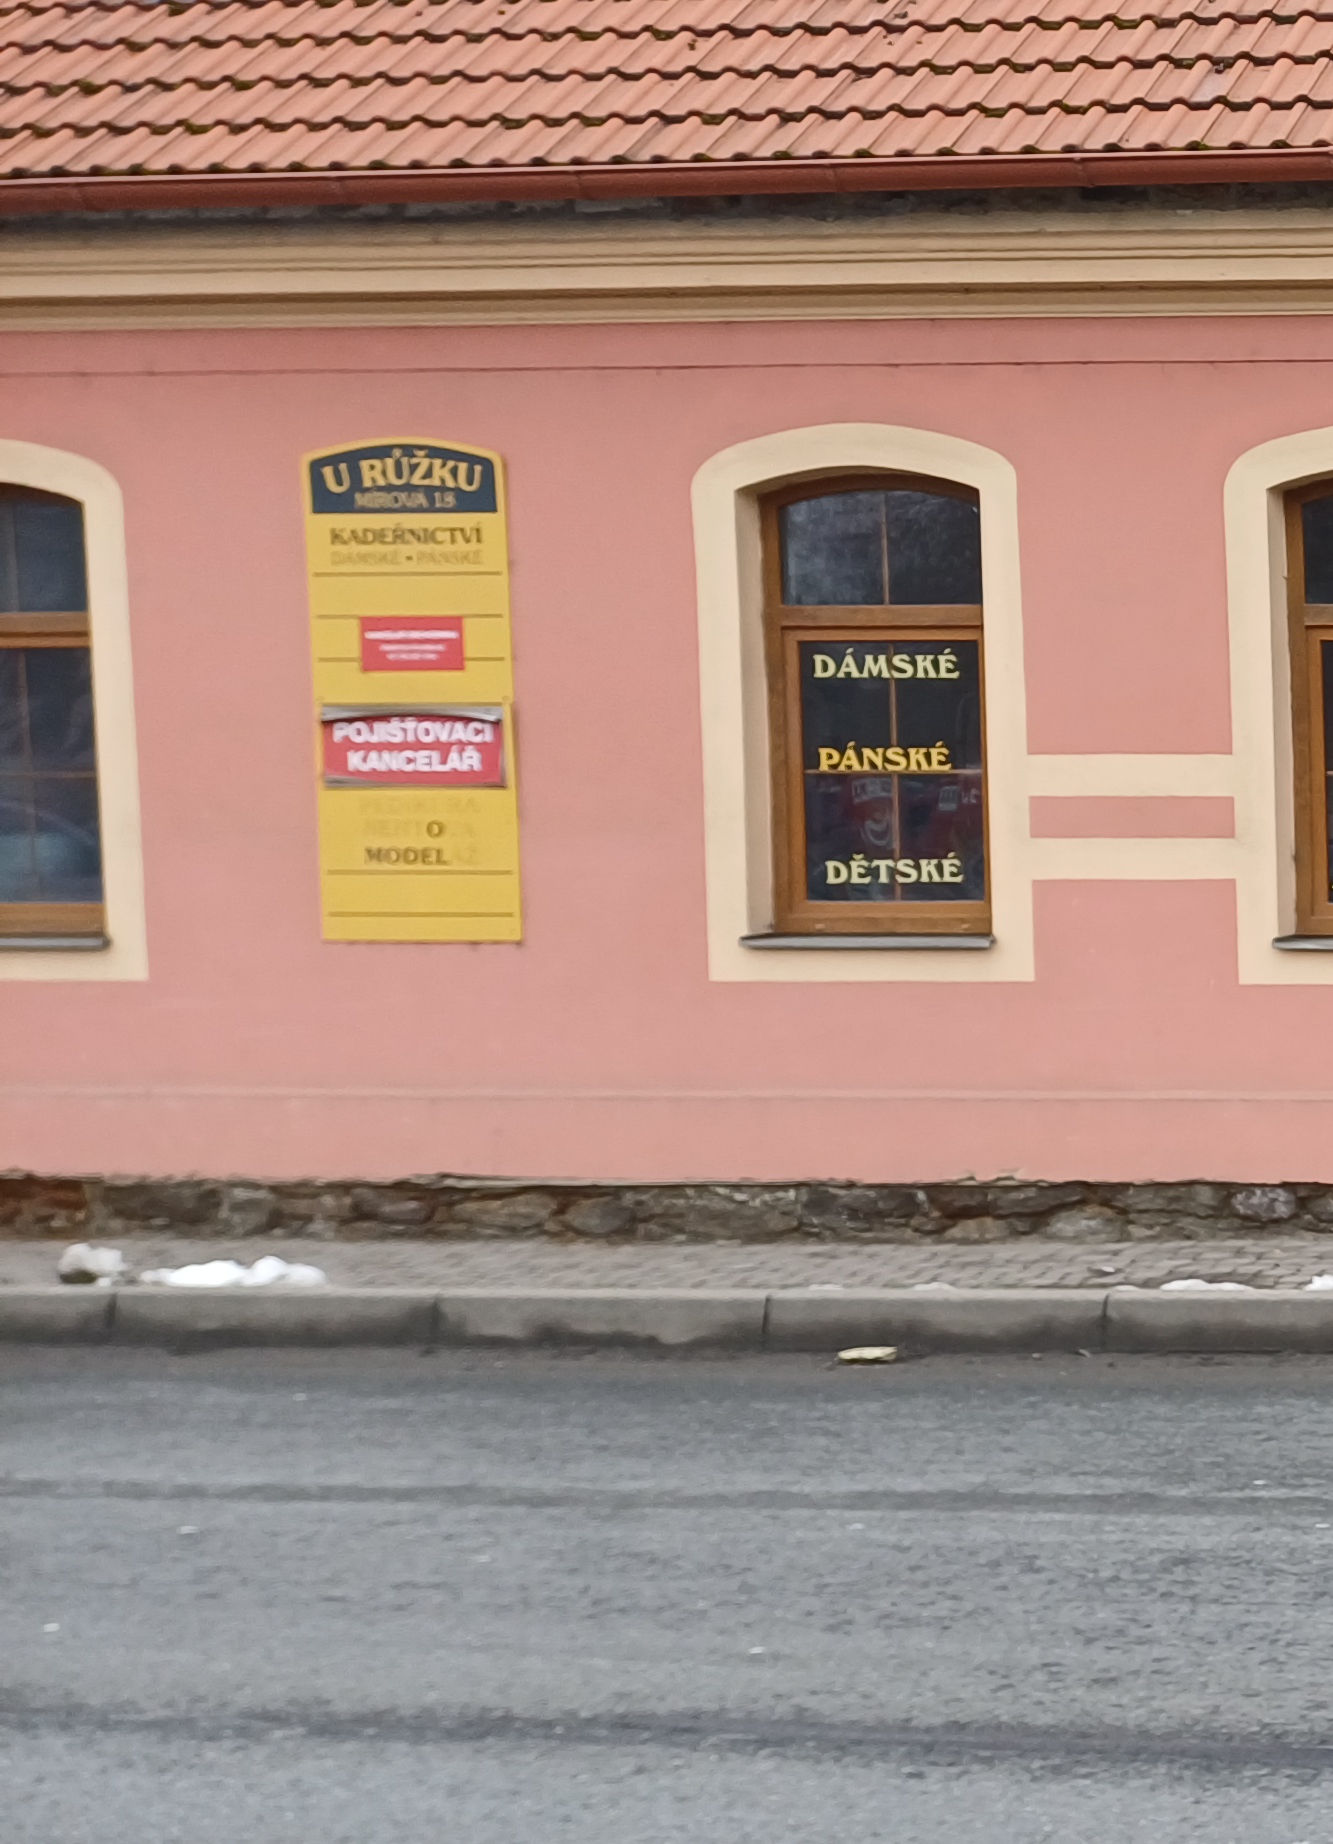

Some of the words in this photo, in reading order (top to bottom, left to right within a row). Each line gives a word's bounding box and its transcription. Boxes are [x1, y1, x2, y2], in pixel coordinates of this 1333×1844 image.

[320, 462, 350, 494] U
[359, 448, 483, 492] RŮŽKU
[330, 522, 483, 545] KADEŘNICTVÍ
[813, 648, 960, 679] DÁMSKÉ
[347, 745, 483, 772] KANCELÁŘ
[818, 741, 952, 772] PÁNSKÉ
[825, 852, 964, 884] DĚTSKÉ
